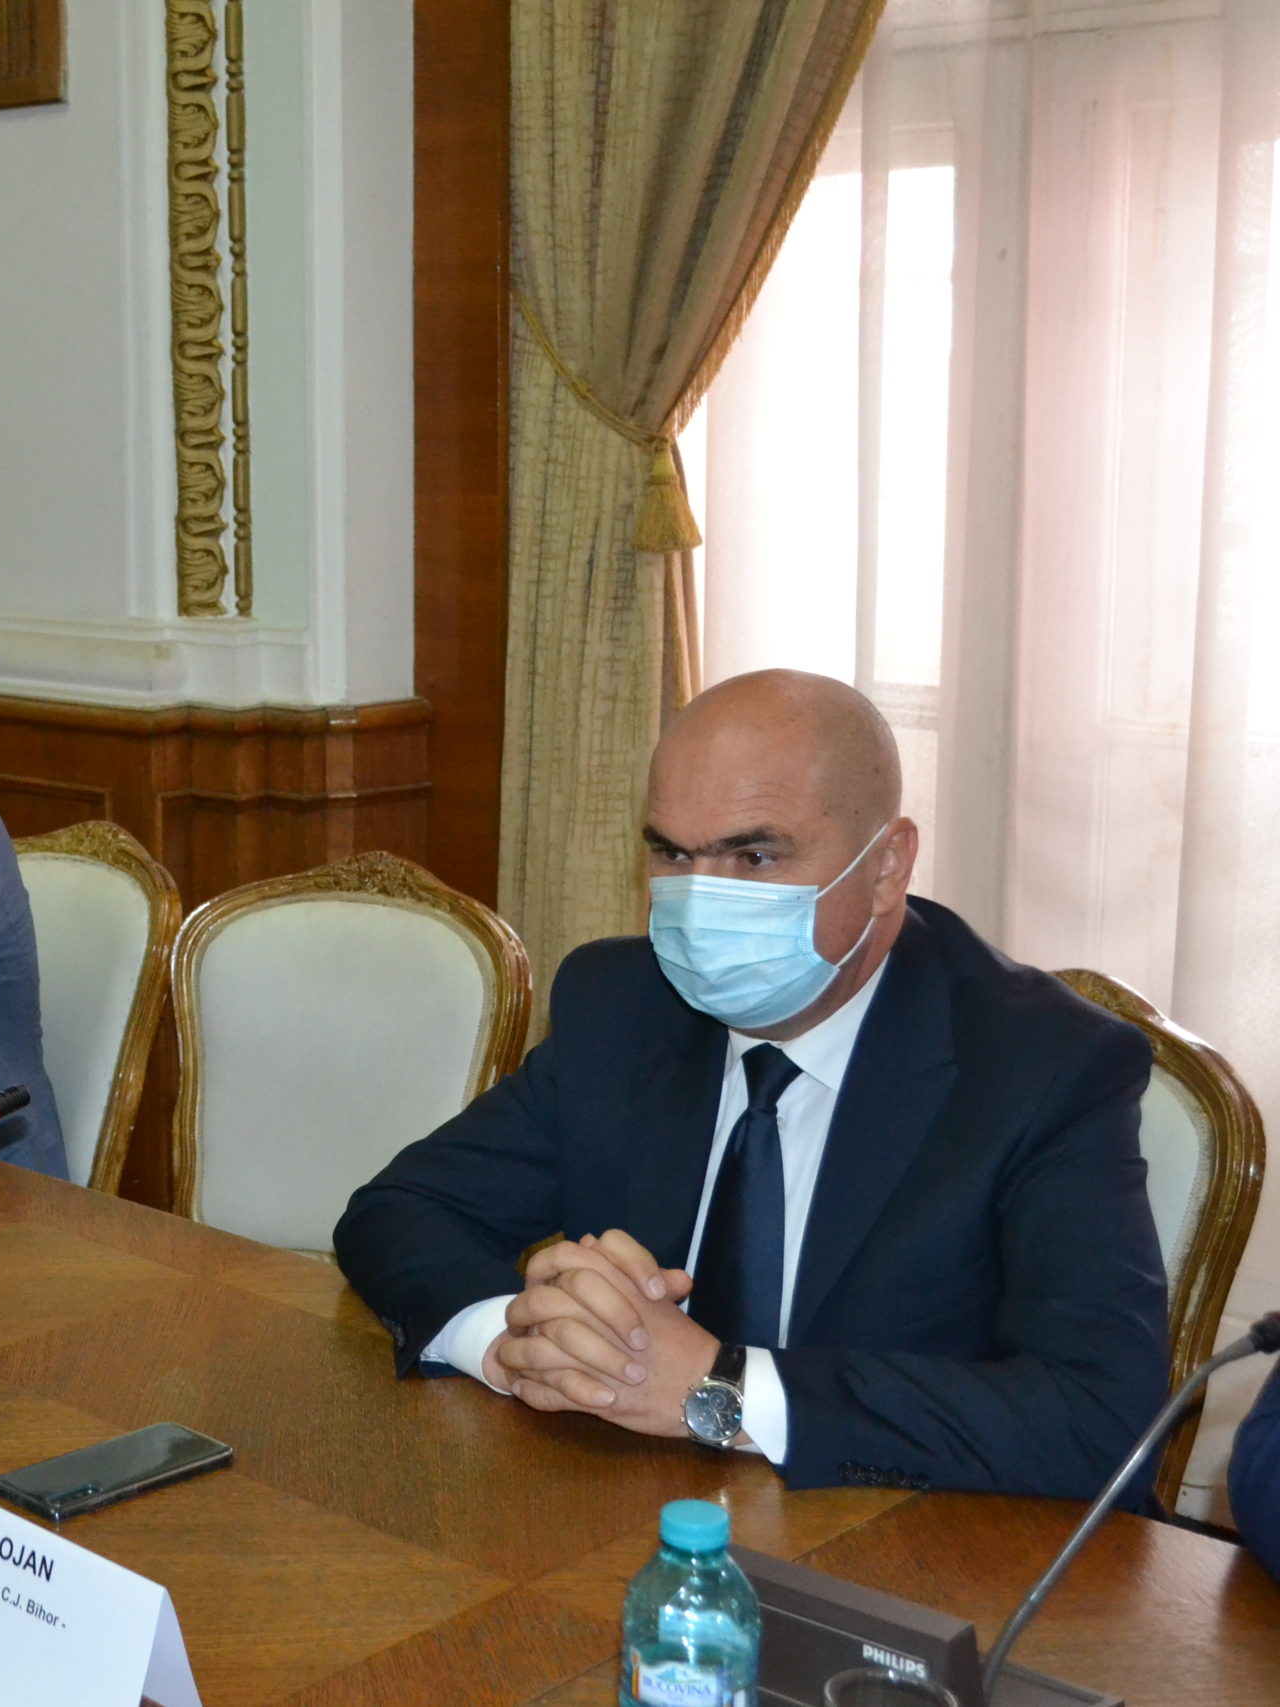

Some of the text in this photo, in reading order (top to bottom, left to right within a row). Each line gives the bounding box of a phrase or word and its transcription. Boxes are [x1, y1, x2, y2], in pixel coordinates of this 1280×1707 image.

[1, 1587, 22, 1610] C.J.
[26, 1598, 59, 1628] Bihor
[862, 1643, 926, 1679] PHILIPS
[642, 1675, 712, 1697] BUCOVINA
